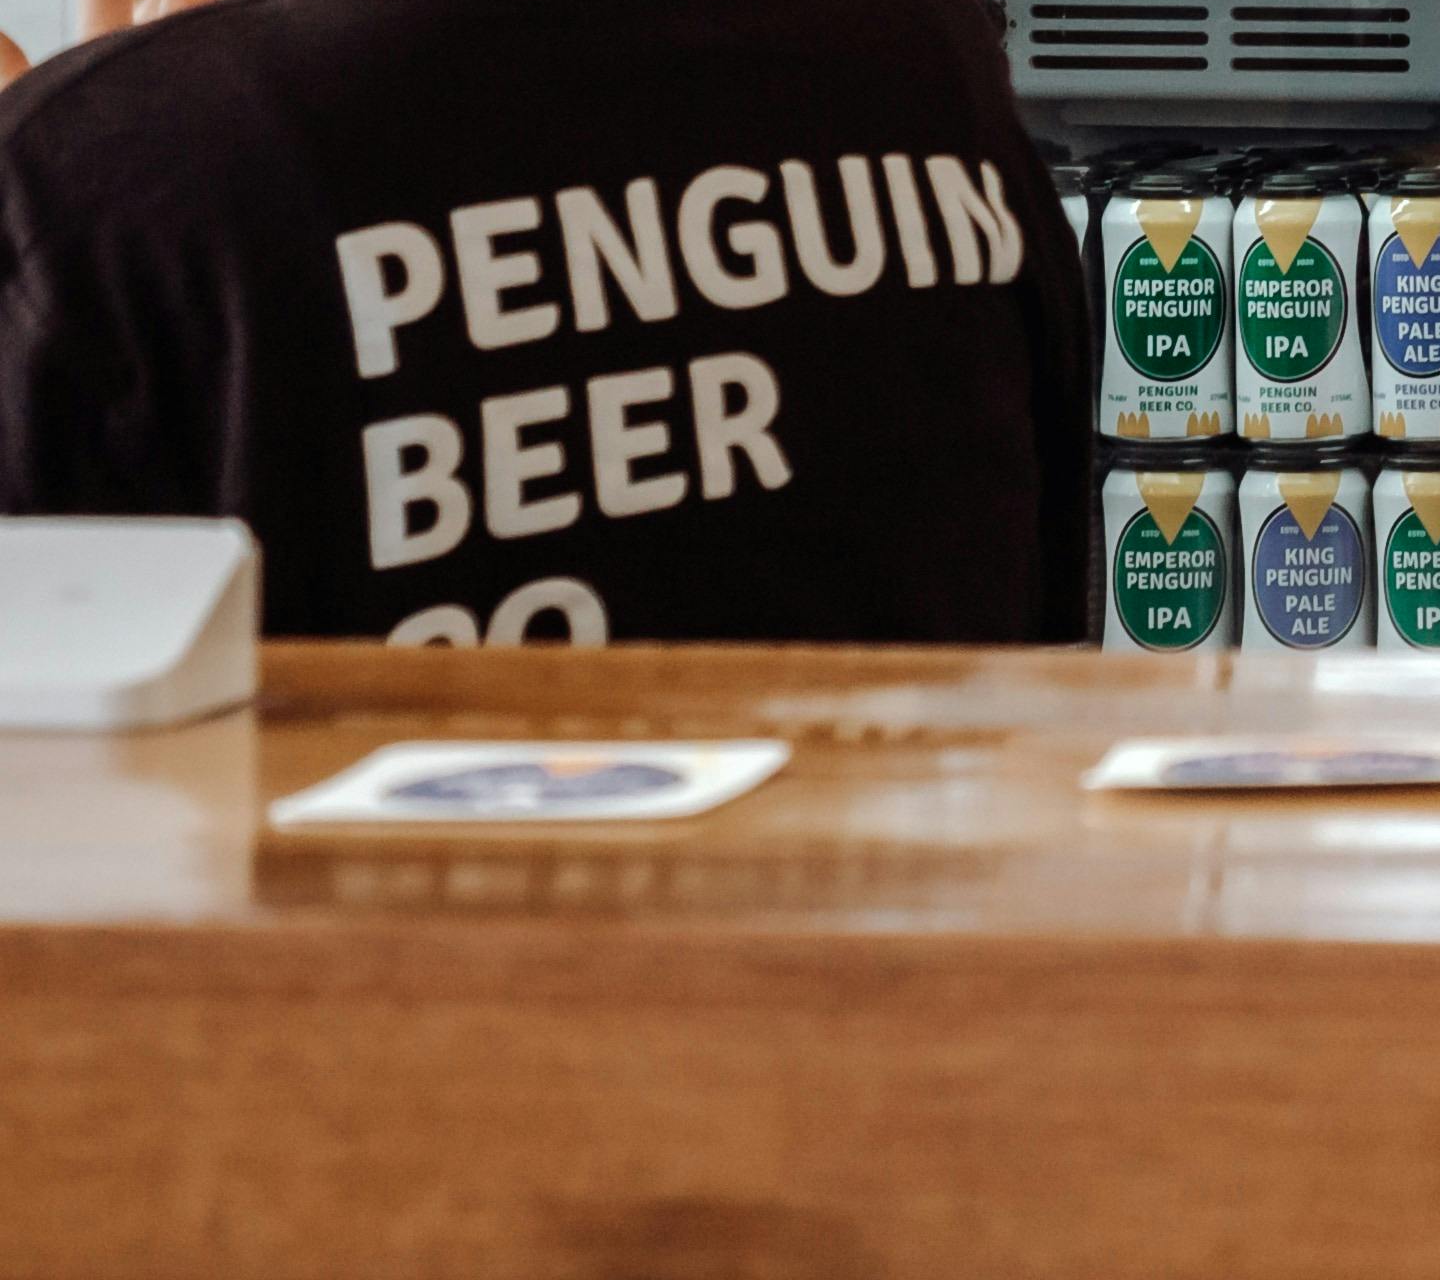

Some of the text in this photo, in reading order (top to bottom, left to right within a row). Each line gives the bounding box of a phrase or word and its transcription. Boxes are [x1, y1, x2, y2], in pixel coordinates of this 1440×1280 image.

[337, 154, 1022, 379] PENGUIN
[1123, 278, 1215, 296] EMPEROR
[1125, 300, 1212, 318] PENGUIN
[1146, 335, 1191, 357] IPA
[1404, 344, 1440, 362] ALE
[362, 352, 792, 570] BEER
